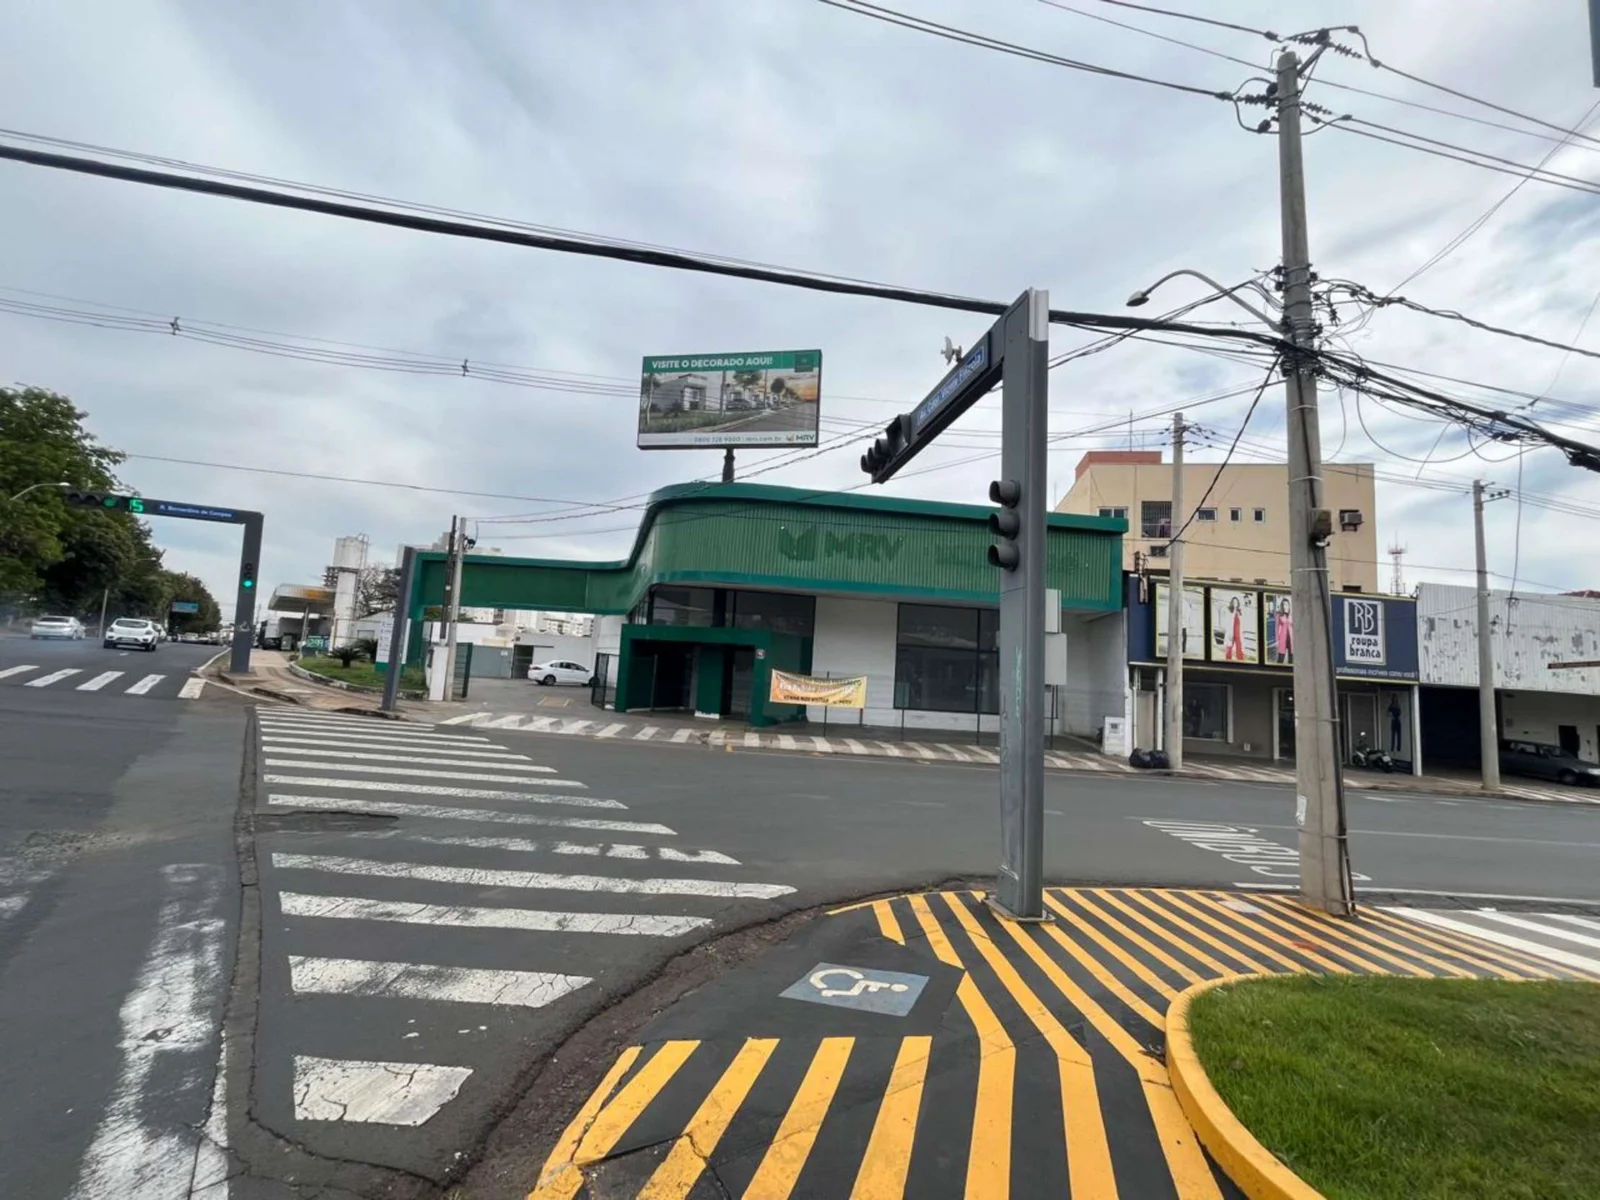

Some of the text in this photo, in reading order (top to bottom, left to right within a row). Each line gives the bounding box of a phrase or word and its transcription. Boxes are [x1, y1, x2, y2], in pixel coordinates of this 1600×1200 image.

[652, 360, 680, 369] VISITE
[681, 360, 689, 368] O
[690, 358, 743, 368] DECORADO
[796, 433, 815, 442] MRV
[1351, 637, 1379, 648] roupa
[1349, 644, 1381, 659] branca
